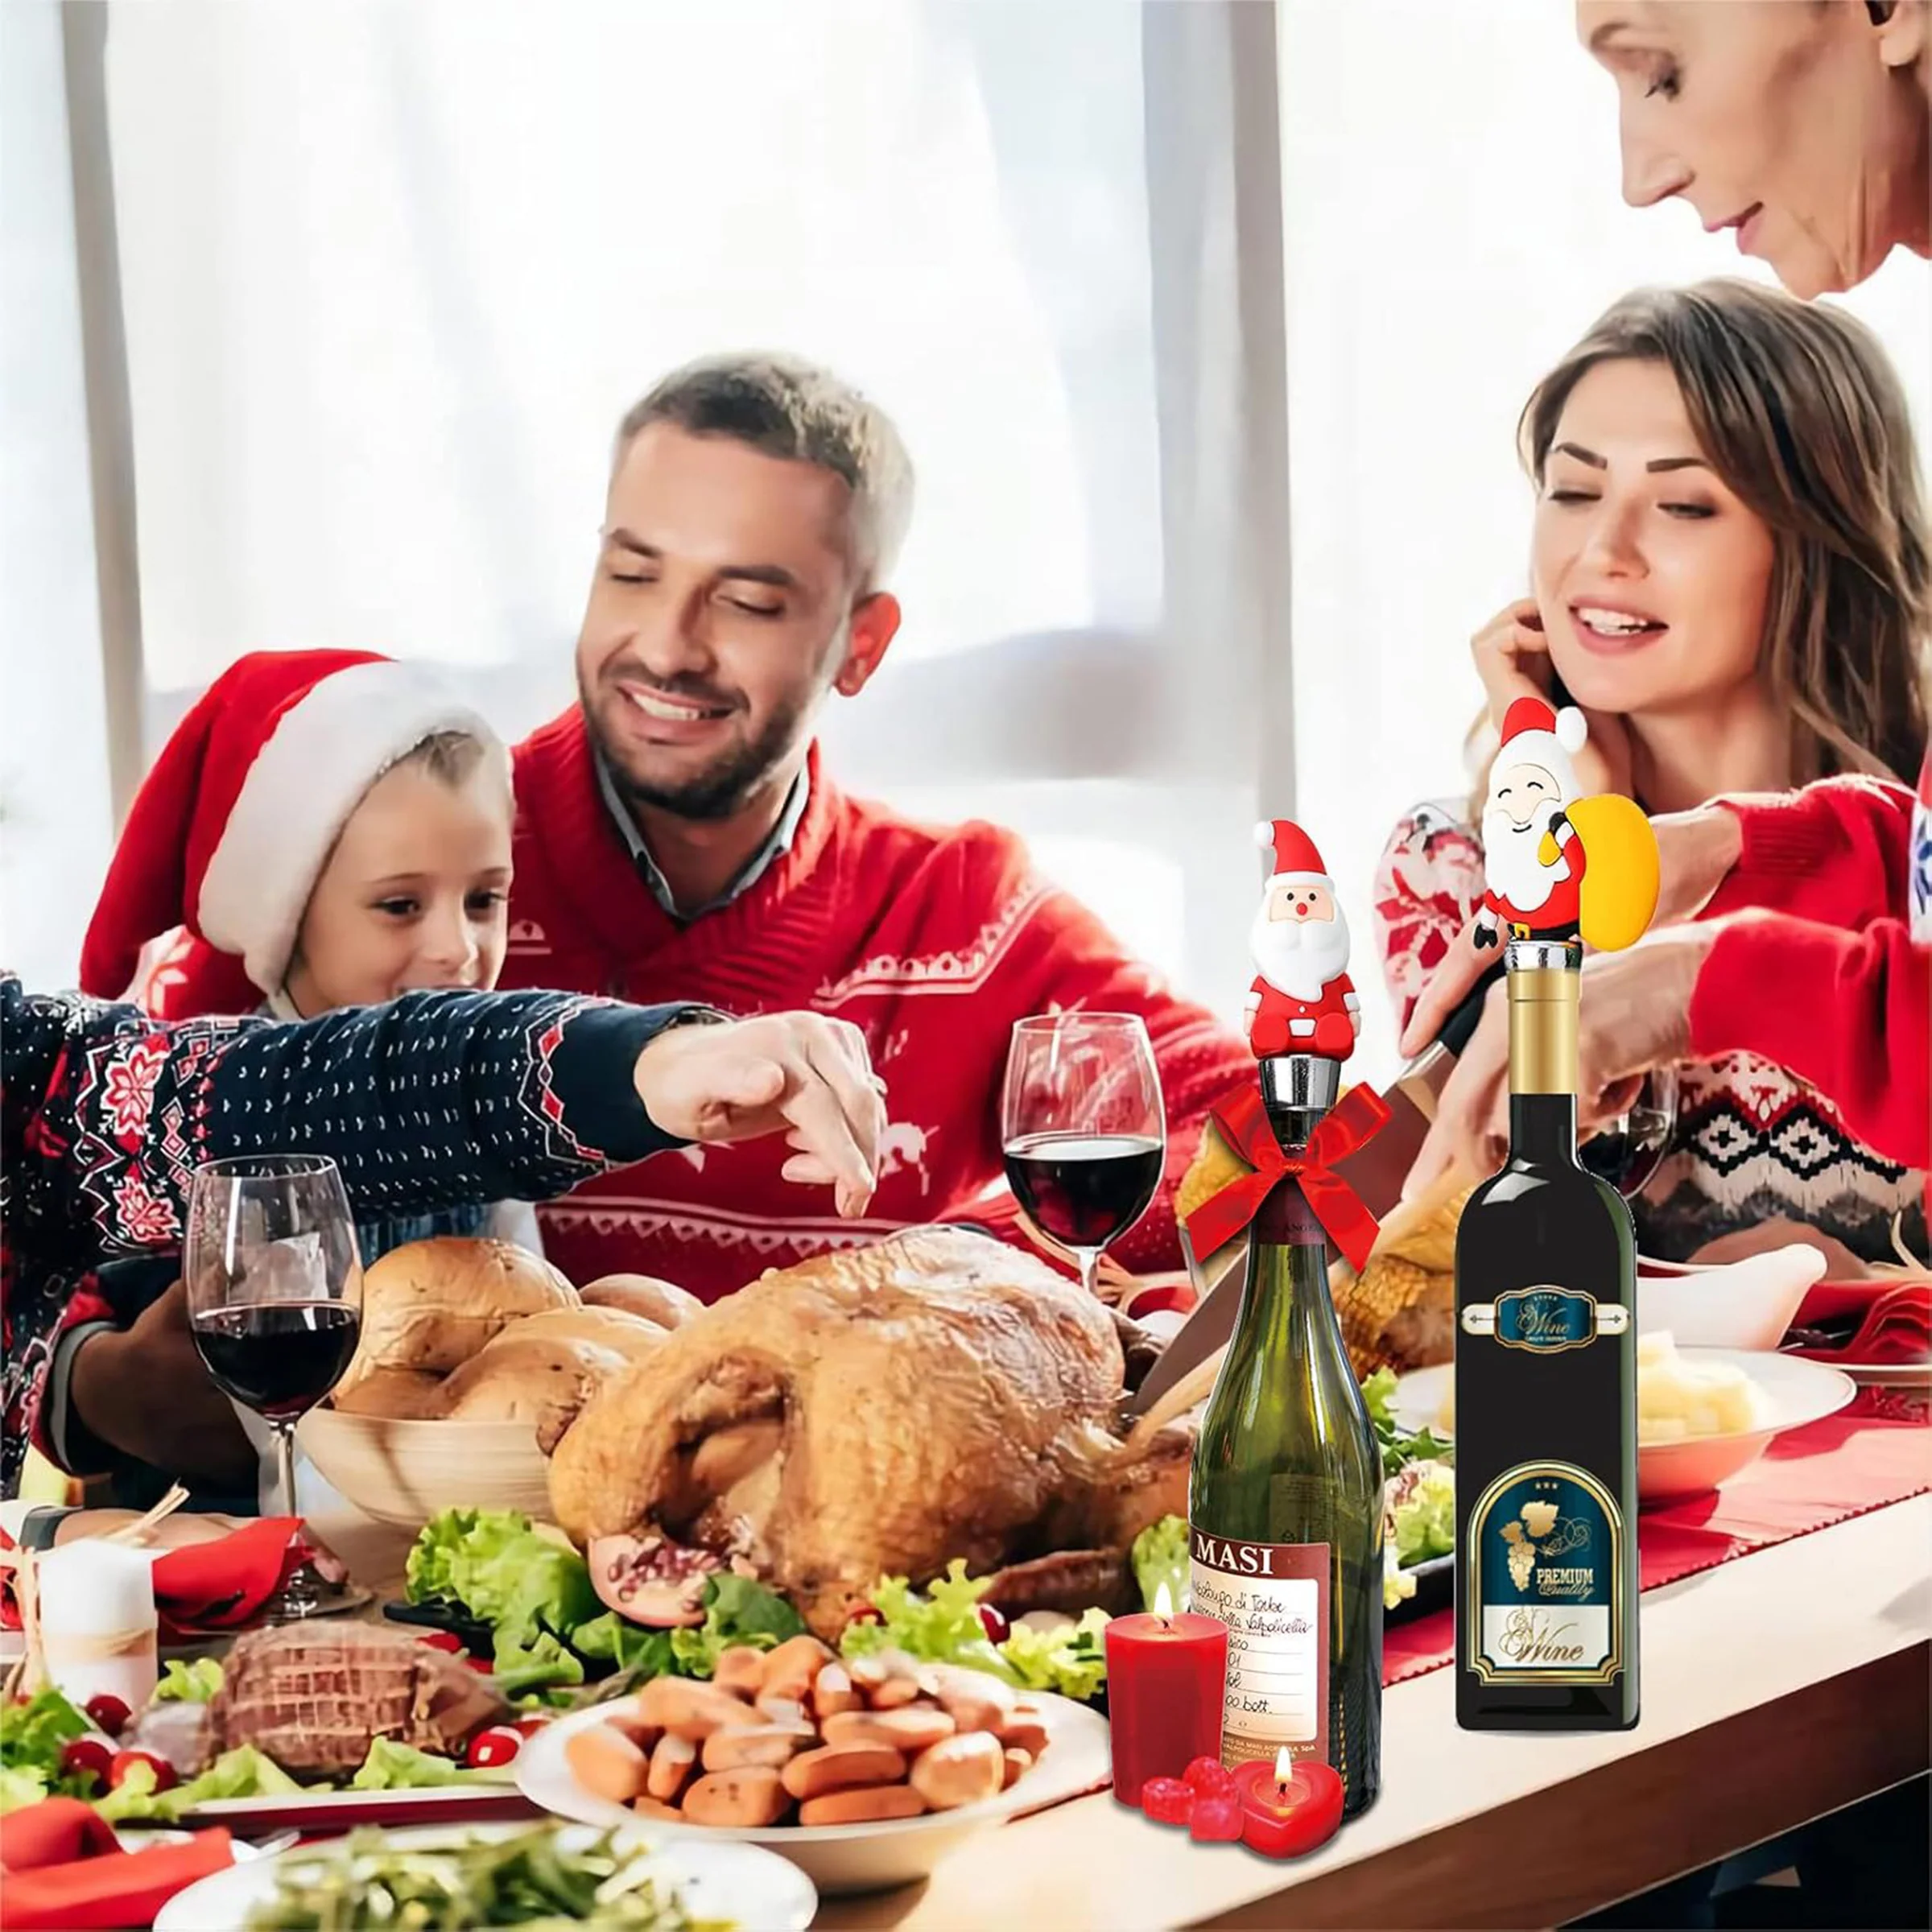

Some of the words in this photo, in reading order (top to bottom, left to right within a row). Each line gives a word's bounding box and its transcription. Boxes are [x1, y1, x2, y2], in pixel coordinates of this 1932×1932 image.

[1517, 1301, 1570, 1335] Wine
[1195, 1533, 1274, 1575] MASI
[1536, 1568, 1594, 1584] PREMIUM
[1235, 1592, 1247, 1609] di
[1538, 1583, 1595, 1602] Quality
[1499, 1608, 1584, 1663] Wine
[1228, 1651, 1241, 1668] 01
